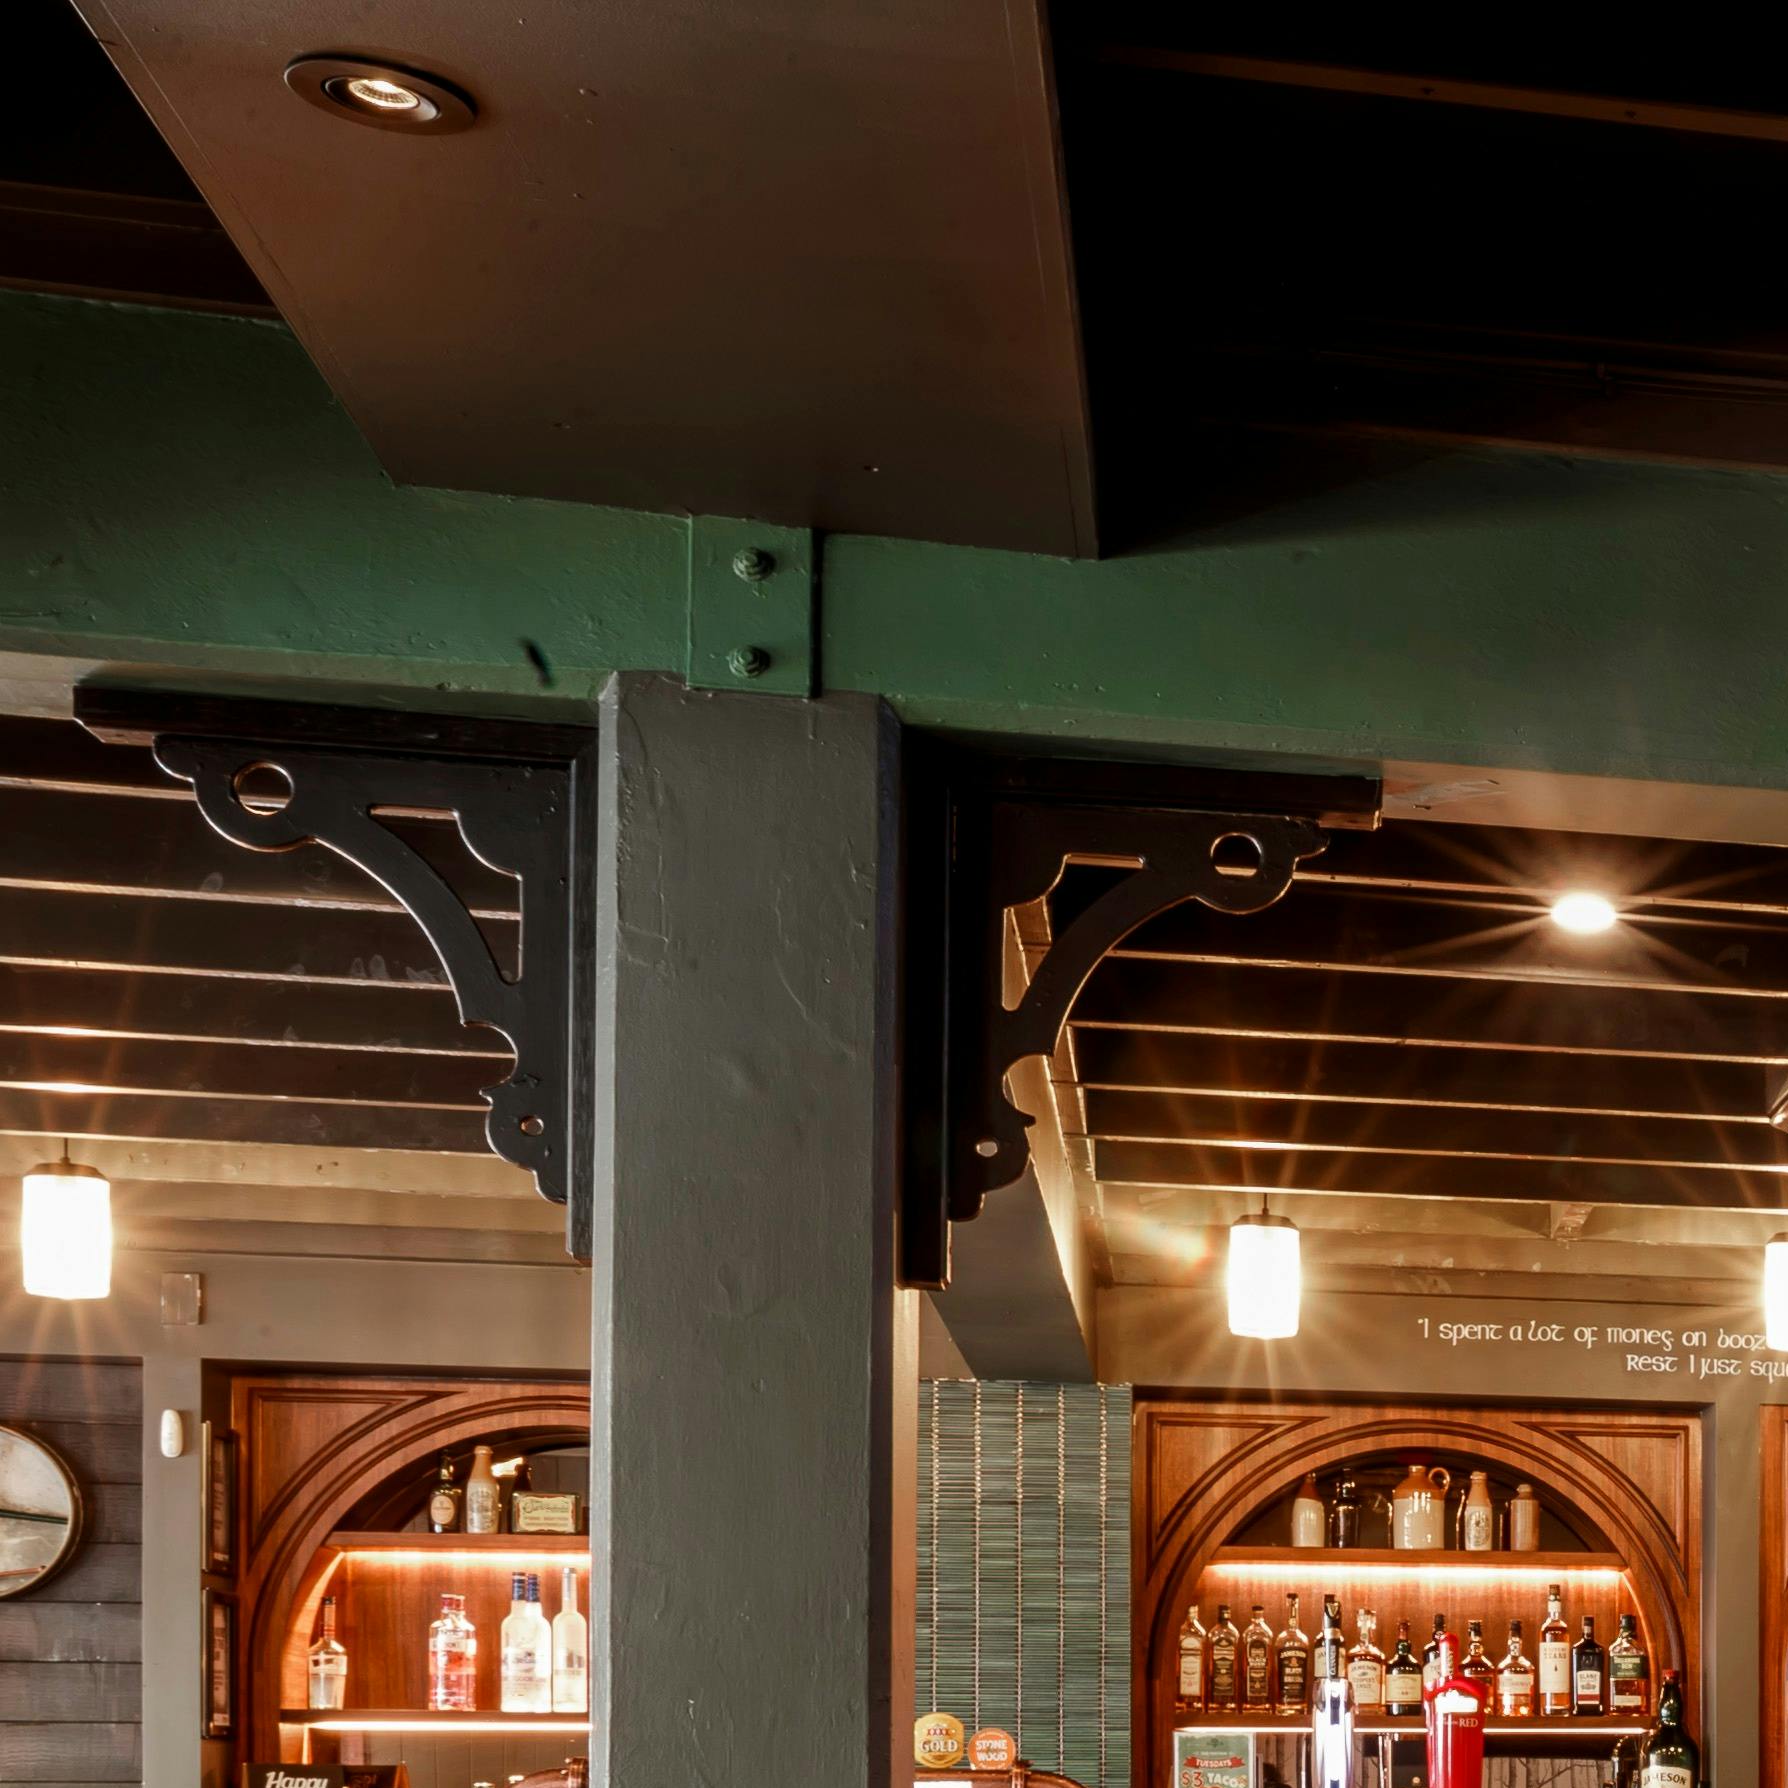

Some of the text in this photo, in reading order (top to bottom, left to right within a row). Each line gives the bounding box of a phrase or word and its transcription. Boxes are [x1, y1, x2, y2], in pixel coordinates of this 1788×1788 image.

[1438, 1321, 1503, 1347] spent
[1509, 1324, 1523, 1342] a
[1527, 1320, 1565, 1342] lot
[1573, 1325, 1599, 1350] of
[1606, 1326, 1675, 1352] money
[1681, 1330, 1707, 1348] on
[1716, 1328, 1767, 1351] booz
[1689, 1354, 1696, 1374] I
[1699, 1355, 1743, 1380] just
[1459, 1718, 1479, 1728] RED
[919, 1739, 959, 1753] GOLD
[975, 1739, 1008, 1750] STONE
[976, 1751, 1008, 1762] WOOD
[1195, 1758, 1233, 1769] TUESDAYS
